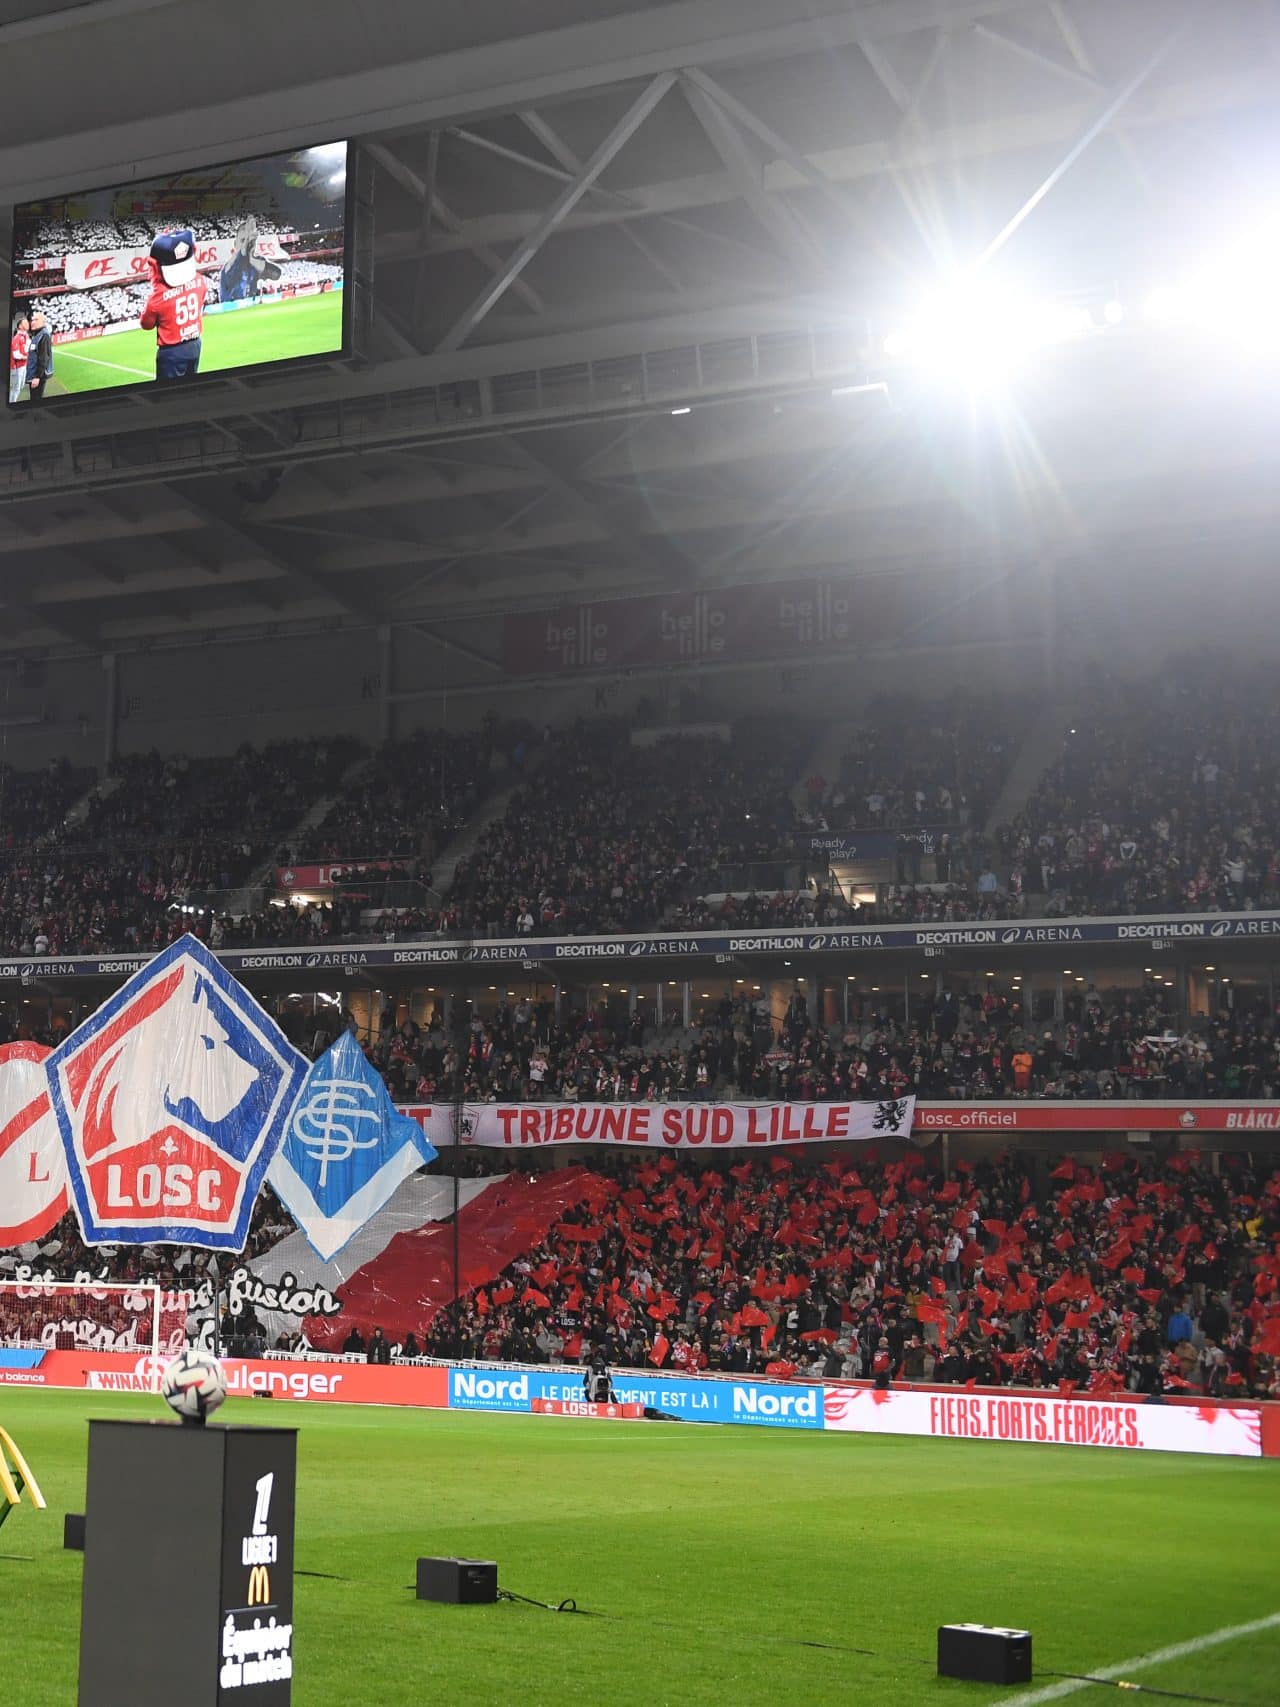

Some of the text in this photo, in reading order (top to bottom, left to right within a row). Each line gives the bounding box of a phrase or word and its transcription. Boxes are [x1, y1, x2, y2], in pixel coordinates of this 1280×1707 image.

[176, 293, 199, 325] 59
[916, 927, 1082, 945] DECATHLON ARENA
[1118, 920, 1280, 938] DECATHLON AREN
[555, 940, 699, 957] DECATHLON ARENA
[730, 934, 883, 951] DECATHLON ARENA
[241, 953, 368, 968] DECATHLON ARENA
[394, 946, 528, 962] DECATHLON ARENA
[36, 963, 75, 974] ARENA
[98, 963, 147, 973] DECATHL
[497, 1106, 850, 1145] TRIBUNE SUD LILLE
[921, 1111, 1018, 1127] losc_officiel
[29, 1152, 50, 1182] L
[107, 1164, 222, 1211] LOSC
[228, 1267, 339, 1315] fusion
[5, 1373, 45, 1382] balance
[225, 1364, 342, 1398] ulanger
[454, 1373, 529, 1400] Nord
[541, 1385, 556, 1401] LE
[662, 1391, 687, 1407] EST
[690, 1390, 709, 1409] LÀ
[733, 1387, 816, 1417] Nord
[562, 1402, 598, 1415] LOSC
